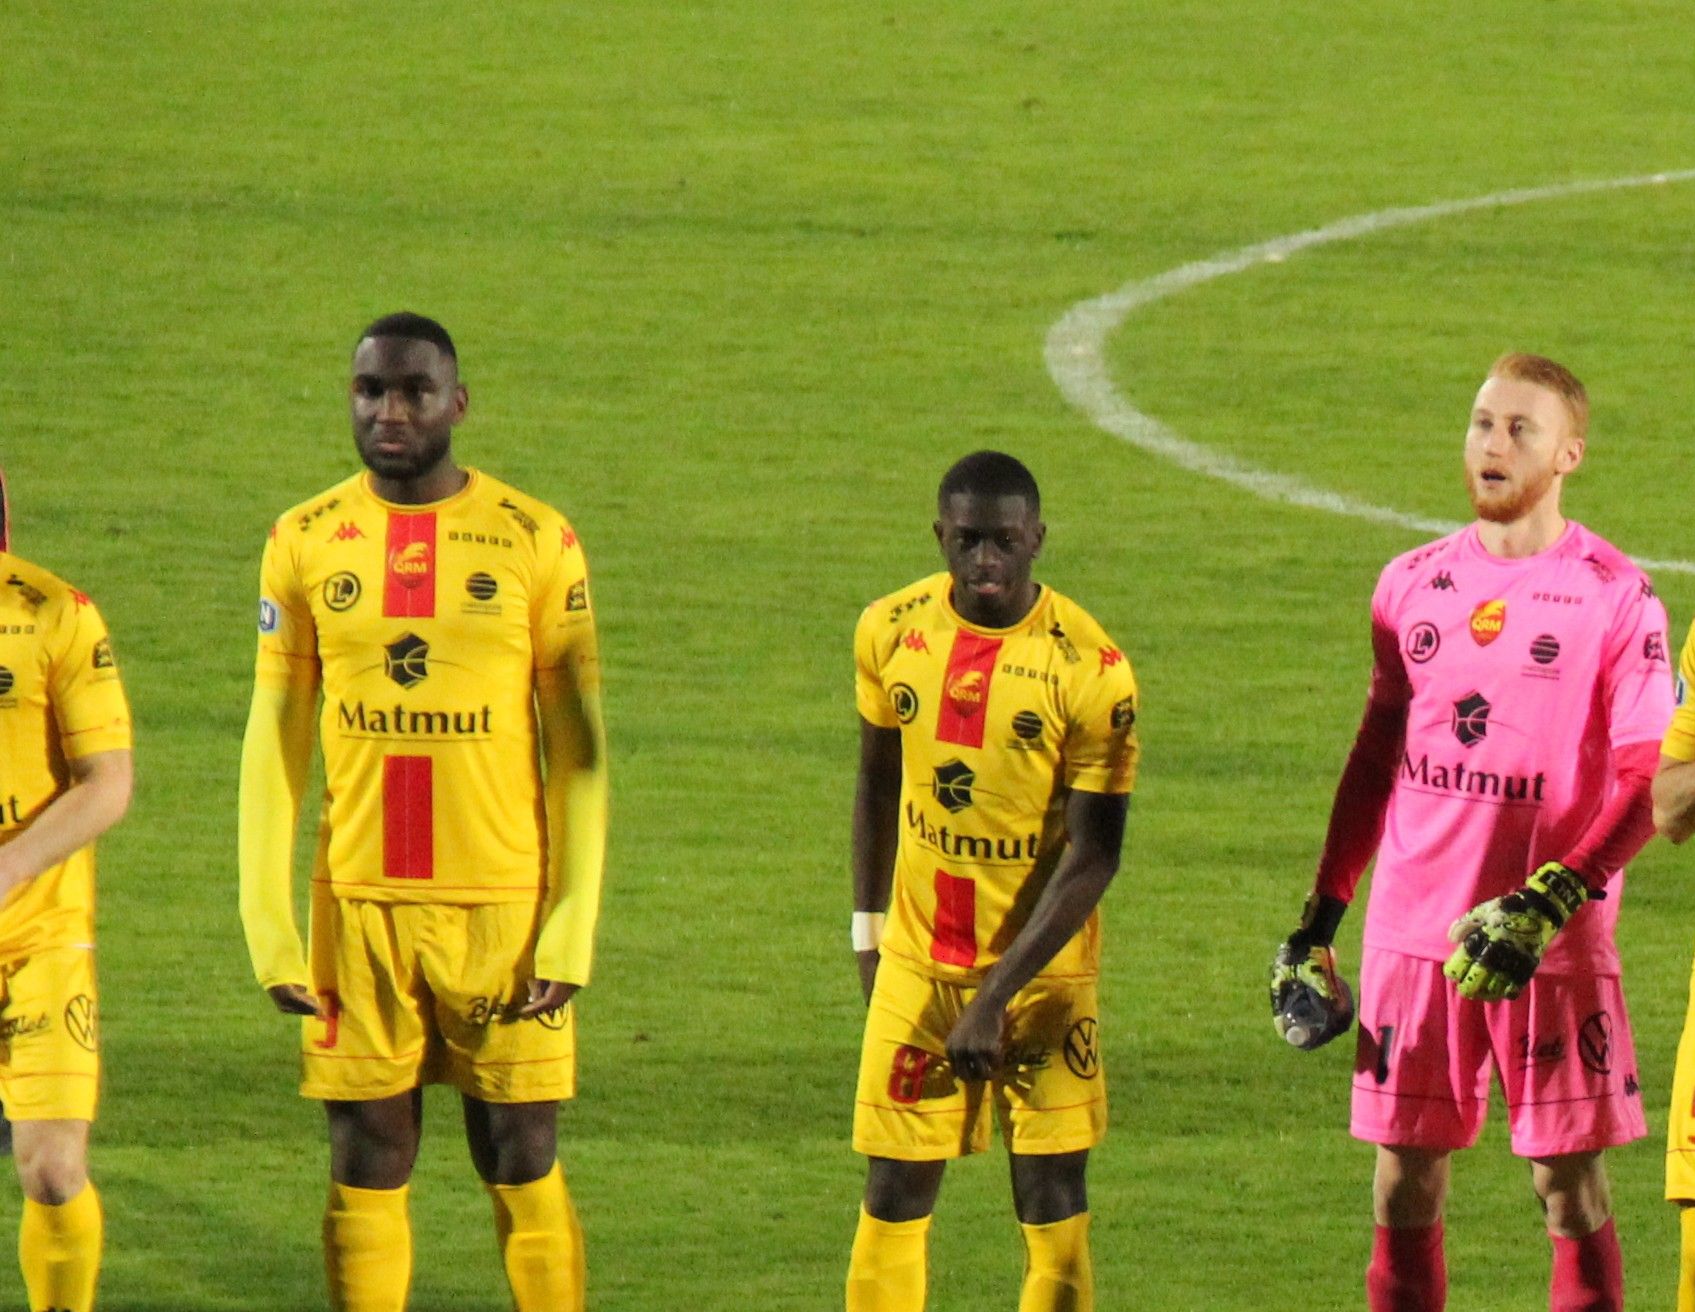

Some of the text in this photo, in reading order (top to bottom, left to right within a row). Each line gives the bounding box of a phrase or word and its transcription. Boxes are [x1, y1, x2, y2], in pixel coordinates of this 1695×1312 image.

[337, 698, 493, 735] Matmut
[1401, 751, 1547, 801] Matmut
[906, 800, 1039, 860] Matmut
